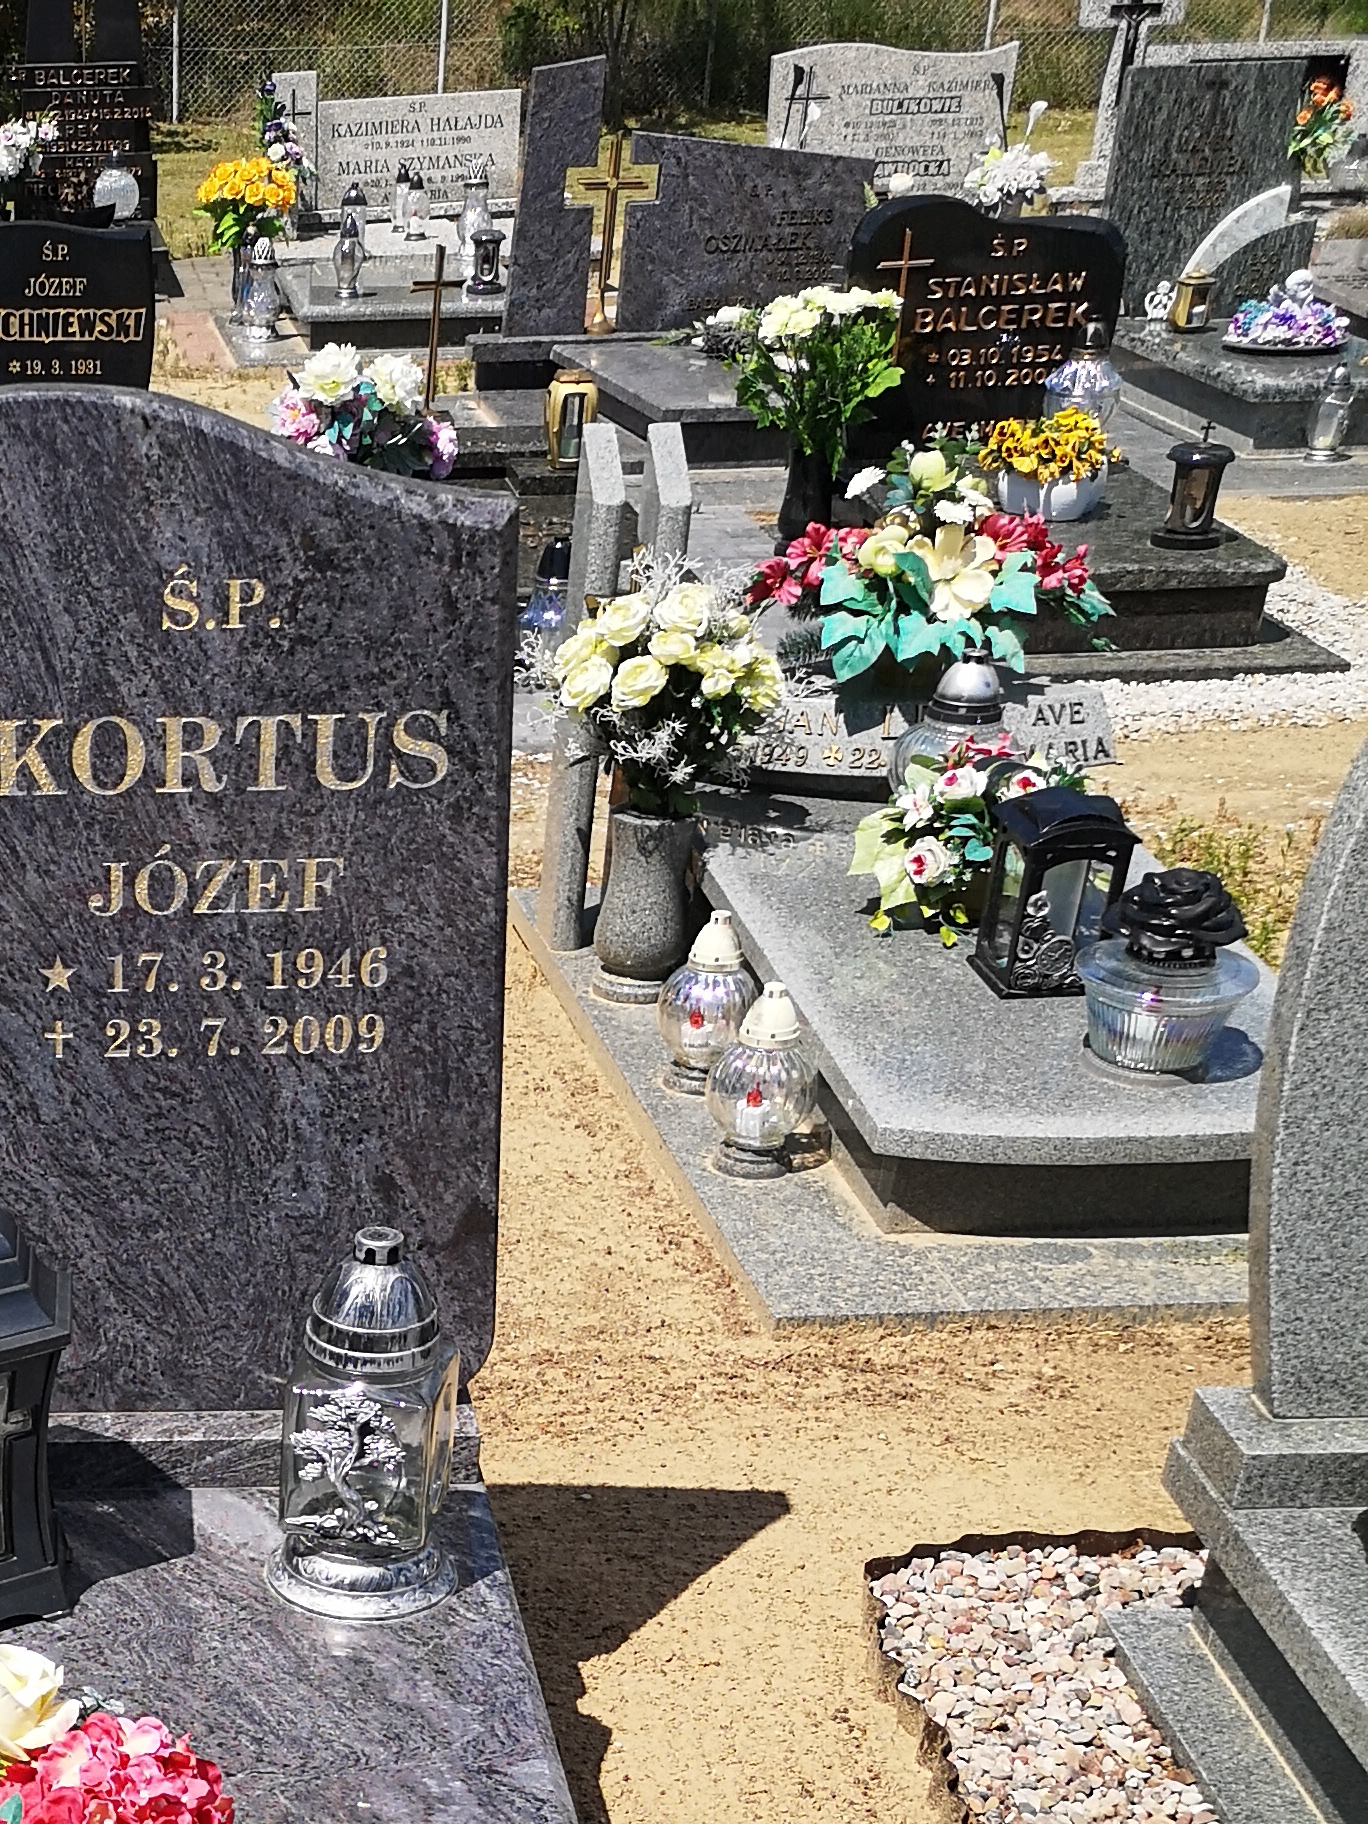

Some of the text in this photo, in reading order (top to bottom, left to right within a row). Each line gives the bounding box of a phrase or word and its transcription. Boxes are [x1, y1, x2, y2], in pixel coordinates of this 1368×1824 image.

[34, 68, 131, 85] BALCEREK
[51, 90, 125, 104] DANUTA
[332, 113, 505, 139] KAZIMIERA HAŁAJDA
[338, 158, 390, 177] MARIA
[42, 240, 70, 261] Ś.P.
[24, 273, 88, 297] JÓZEF
[927, 270, 1088, 299] STANISŁAW
[913, 300, 1090, 334] BALCEREK
[25, 359, 46, 376] 19.
[70, 359, 103, 376] 1931
[948, 367, 1056, 389] 11.10.200
[161, 564, 284, 631] Ś.P.
[1032, 702, 1085, 726] AVE
[87, 844, 345, 917] JÓZEF
[105, 945, 389, 993] 17. 3. 1946
[104, 1013, 386, 1058] 23. 7. 2009
